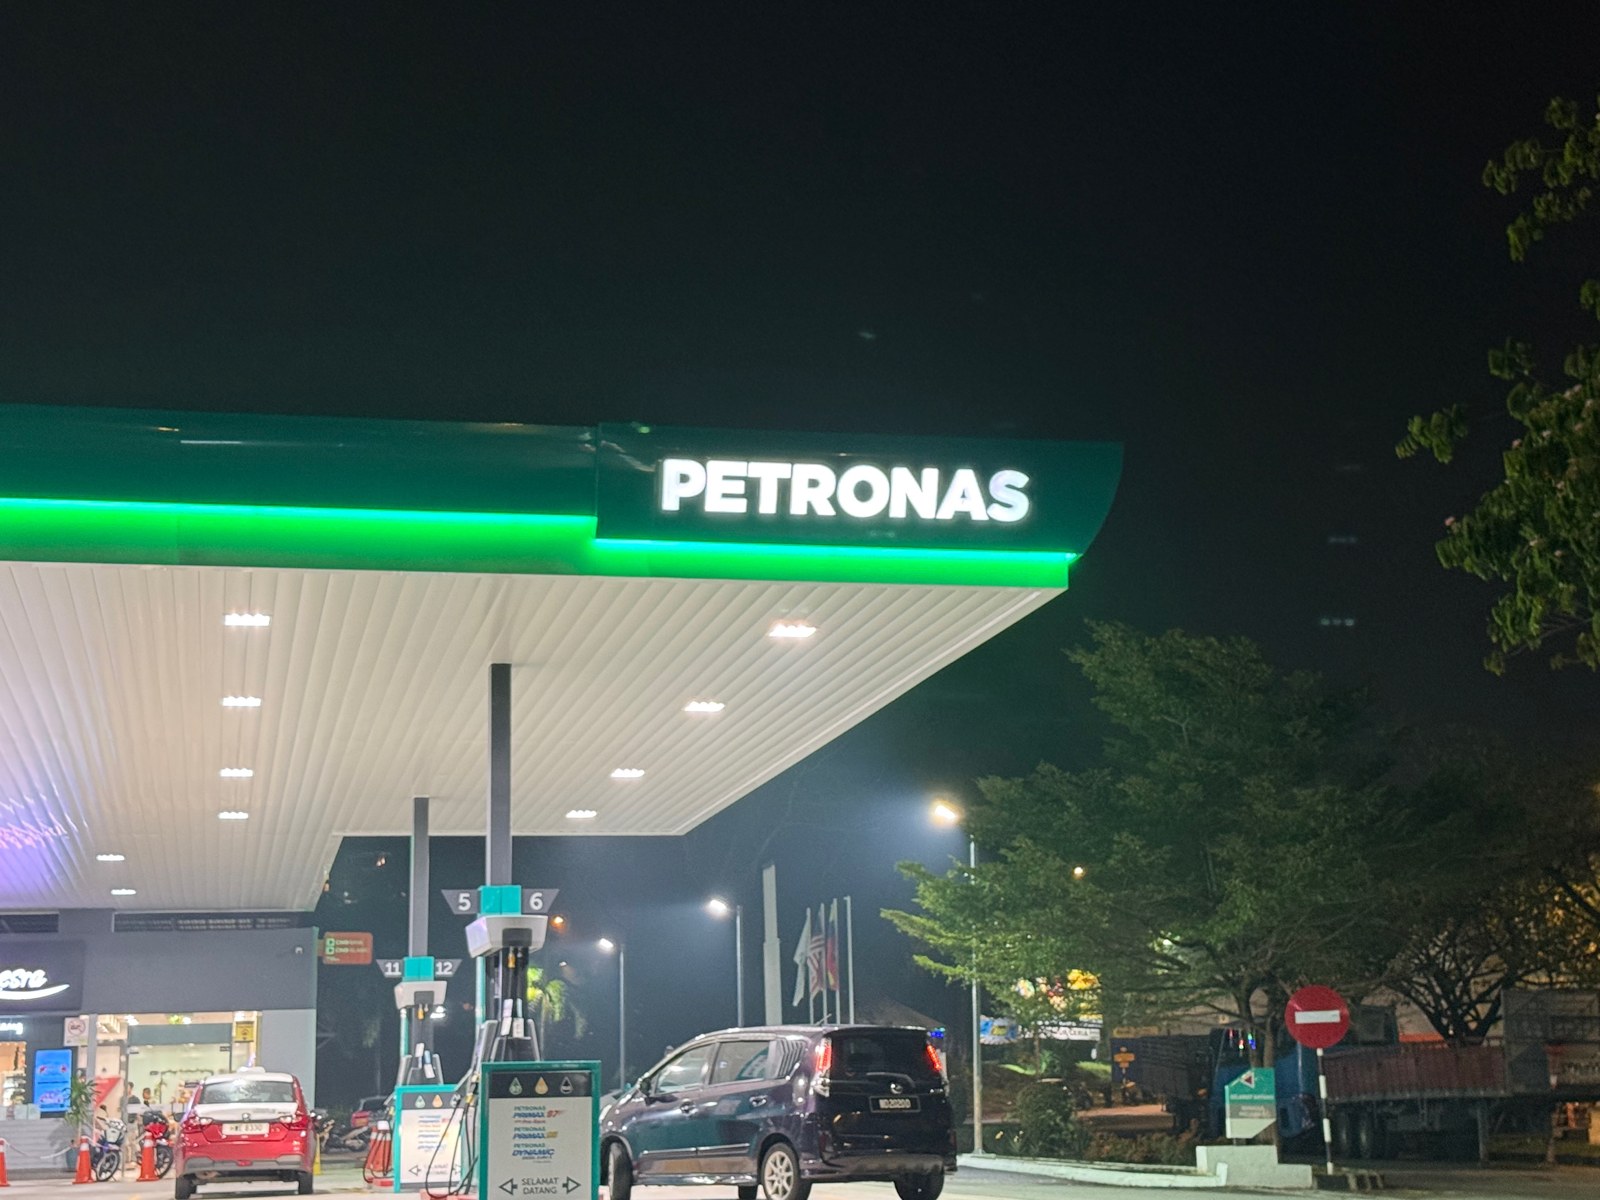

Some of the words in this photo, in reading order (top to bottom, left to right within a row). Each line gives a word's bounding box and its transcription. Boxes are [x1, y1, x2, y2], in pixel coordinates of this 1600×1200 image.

[661, 458, 1030, 522] PETRONAS
[458, 892, 472, 911] 5
[529, 892, 543, 911] 6
[385, 962, 402, 976] 11
[435, 962, 453, 976] 12
[521, 1177, 559, 1186] SELAMAT
[523, 1186, 557, 1195] DATANG
